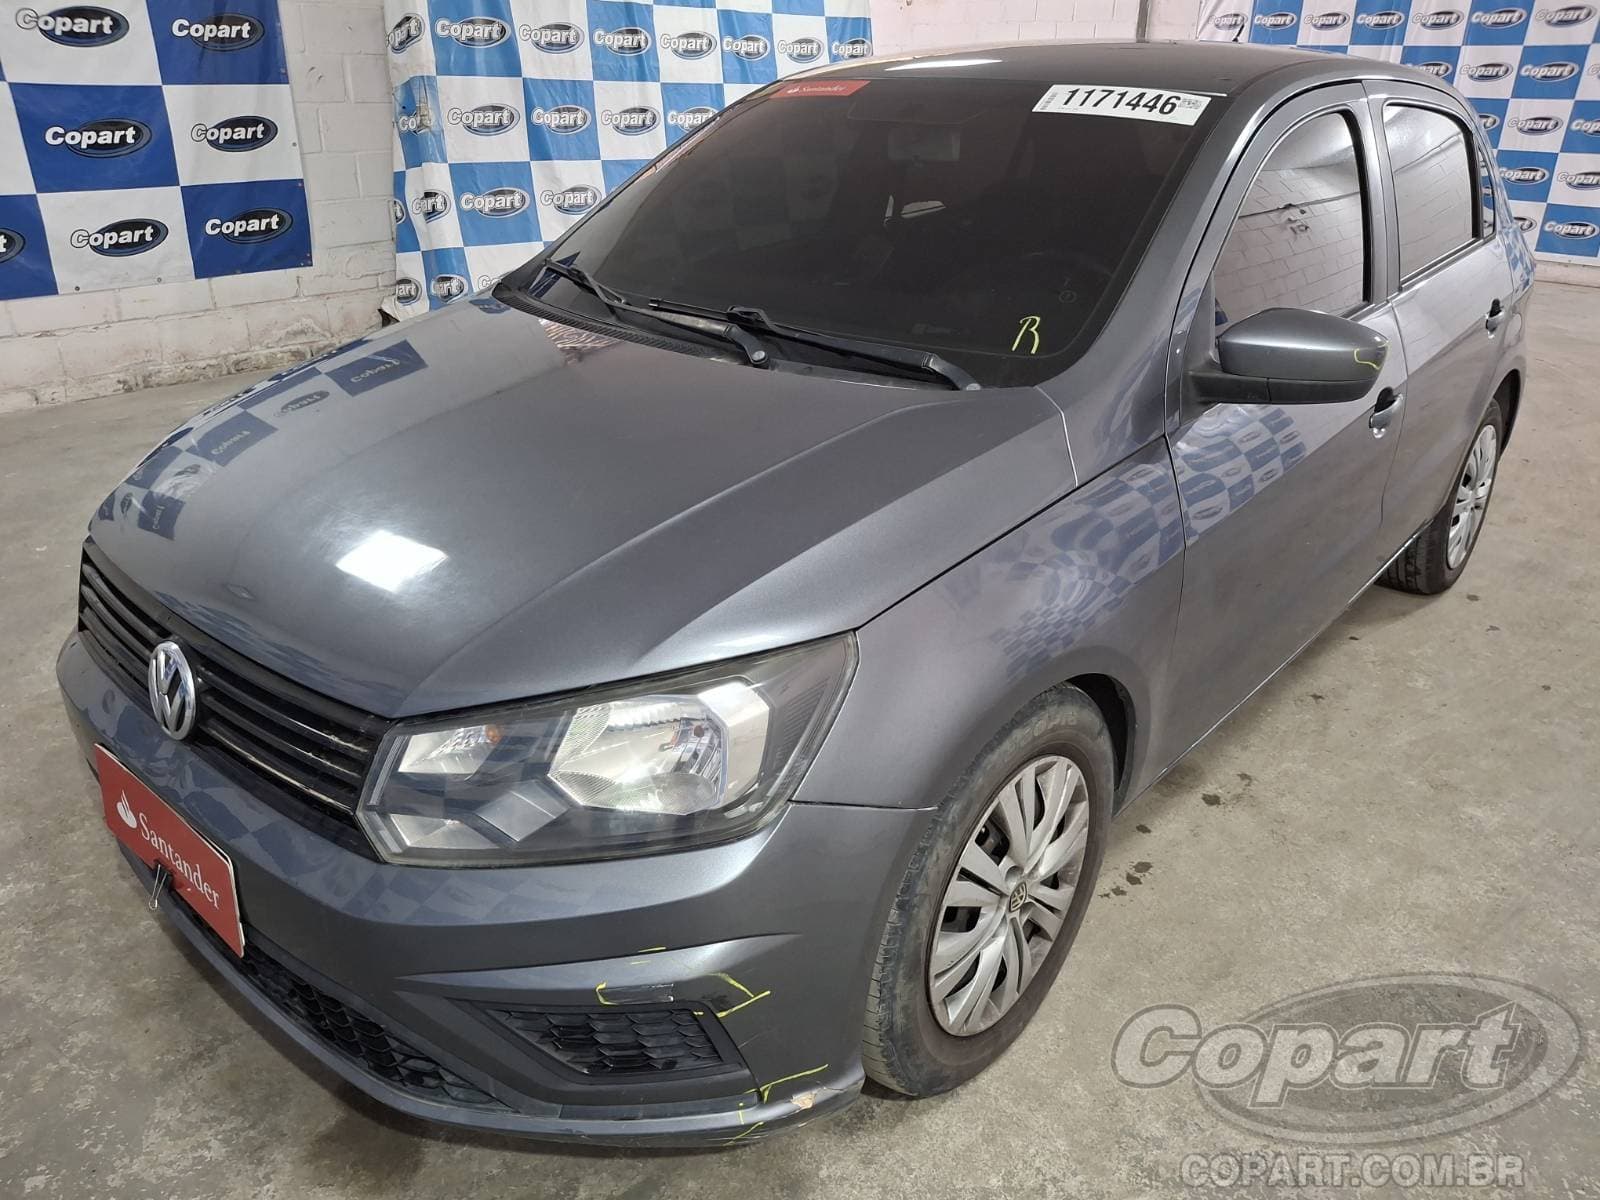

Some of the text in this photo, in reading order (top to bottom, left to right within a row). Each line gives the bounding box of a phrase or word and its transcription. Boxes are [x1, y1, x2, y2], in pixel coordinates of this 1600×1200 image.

[16, 8, 114, 36] Copart
[1255, 14, 1292, 27] Copart
[1304, 13, 1343, 27] Copart
[1356, 14, 1400, 27] Copart
[1412, 12, 1457, 26] Copart
[1472, 11, 1521, 25] Copart
[1535, 8, 1588, 23] Copart
[172, 19, 251, 41] Copart
[435, 18, 501, 44] Copart
[519, 24, 577, 47] Copart
[593, 30, 648, 47] Copart
[660, 34, 708, 52] Copart
[723, 37, 765, 53] Copart
[778, 40, 818, 55] Copart
[831, 42, 869, 56] Copart
[1460, 64, 1507, 78] Copart
[1520, 63, 1572, 78] Copart
[1063, 88, 1181, 115] 1171446
[447, 107, 511, 127] Copart
[532, 107, 585, 127] Copart
[601, 110, 654, 128] Copart
[1508, 118, 1559, 132] Copart
[45, 125, 136, 148] Copart
[191, 123, 265, 143] Copart
[1557, 172, 1600, 185] Copar
[460, 188, 525, 212] Copart
[540, 189, 594, 208] Copart
[205, 214, 280, 238] Copart
[1544, 221, 1593, 236] Copart
[71, 226, 153, 249] Copart
[139, 813, 220, 909] Santander
